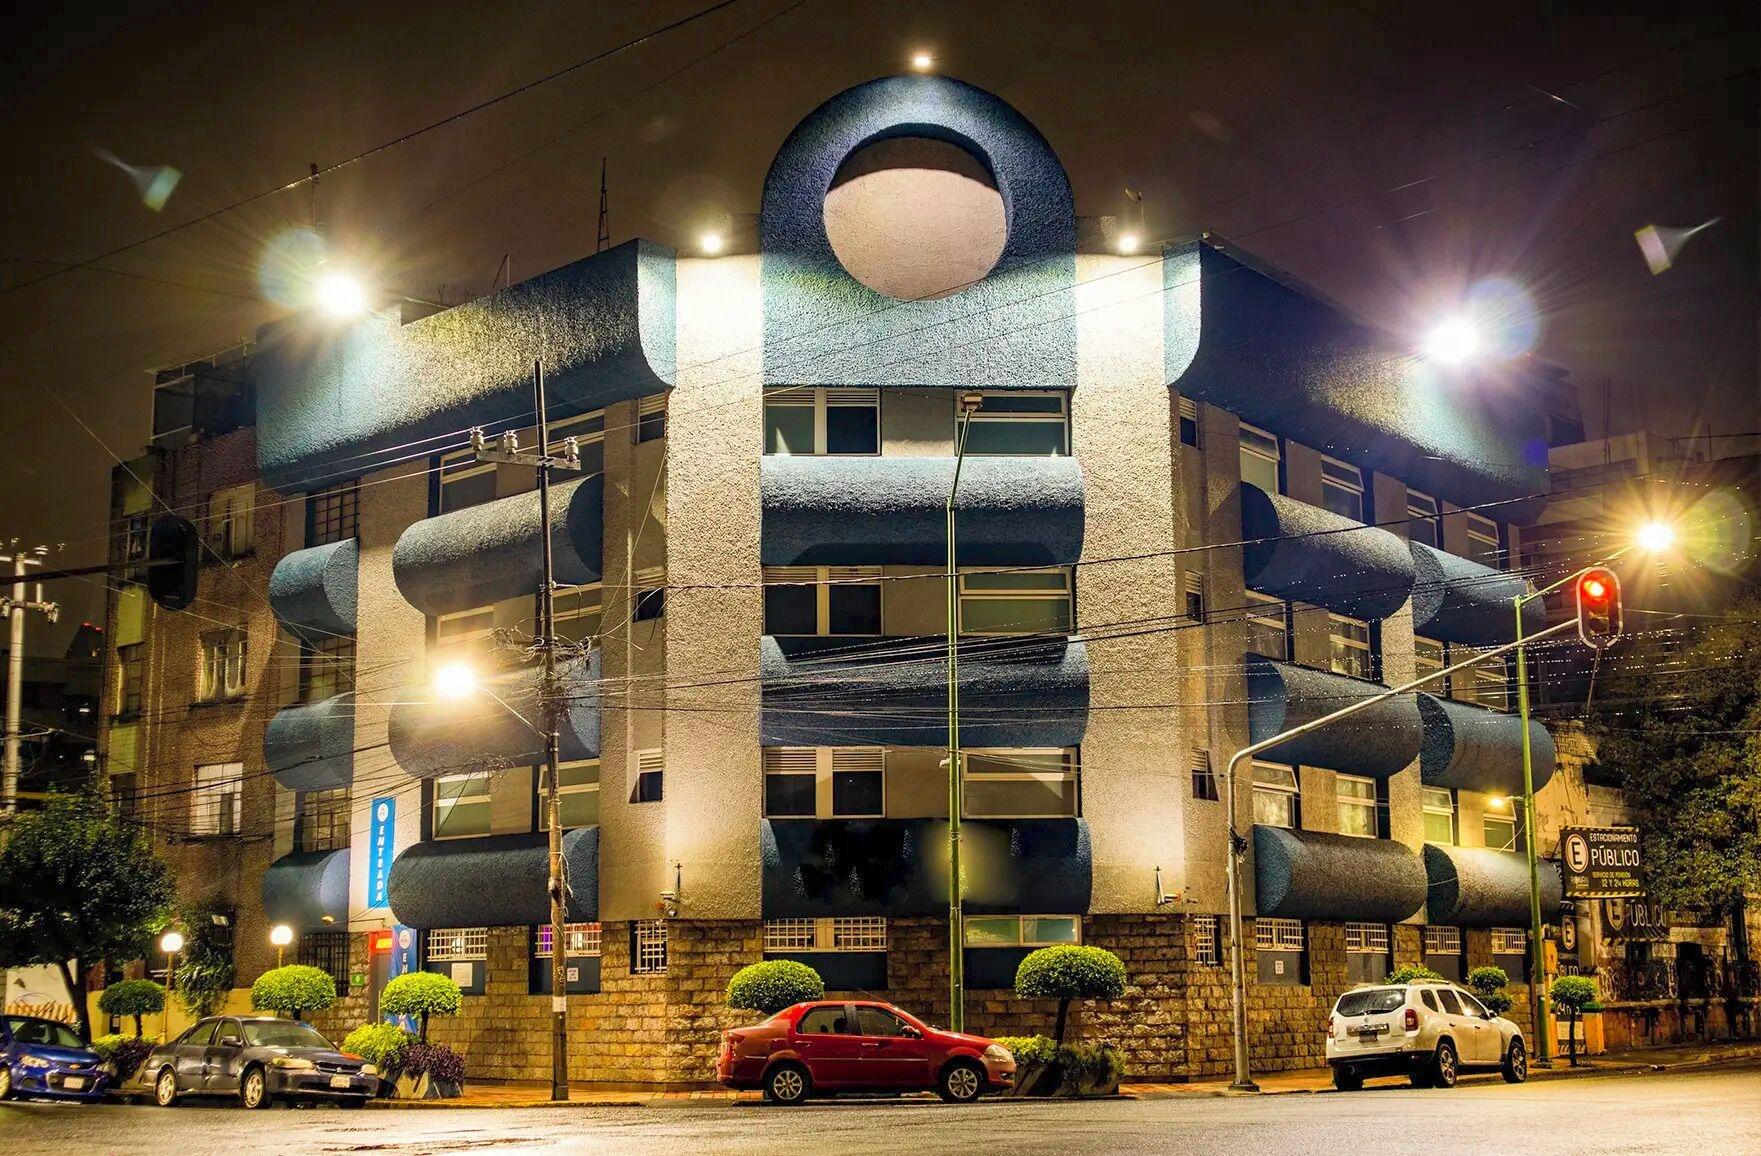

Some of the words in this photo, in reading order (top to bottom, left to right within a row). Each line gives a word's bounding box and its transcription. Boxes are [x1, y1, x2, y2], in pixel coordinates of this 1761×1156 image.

[1589, 832, 1638, 843] ESTACIONAMIENTO
[376, 825, 385, 902] ENTRADA
[1571, 841, 1582, 865] E
[1591, 845, 1640, 866] PÚBLICO
